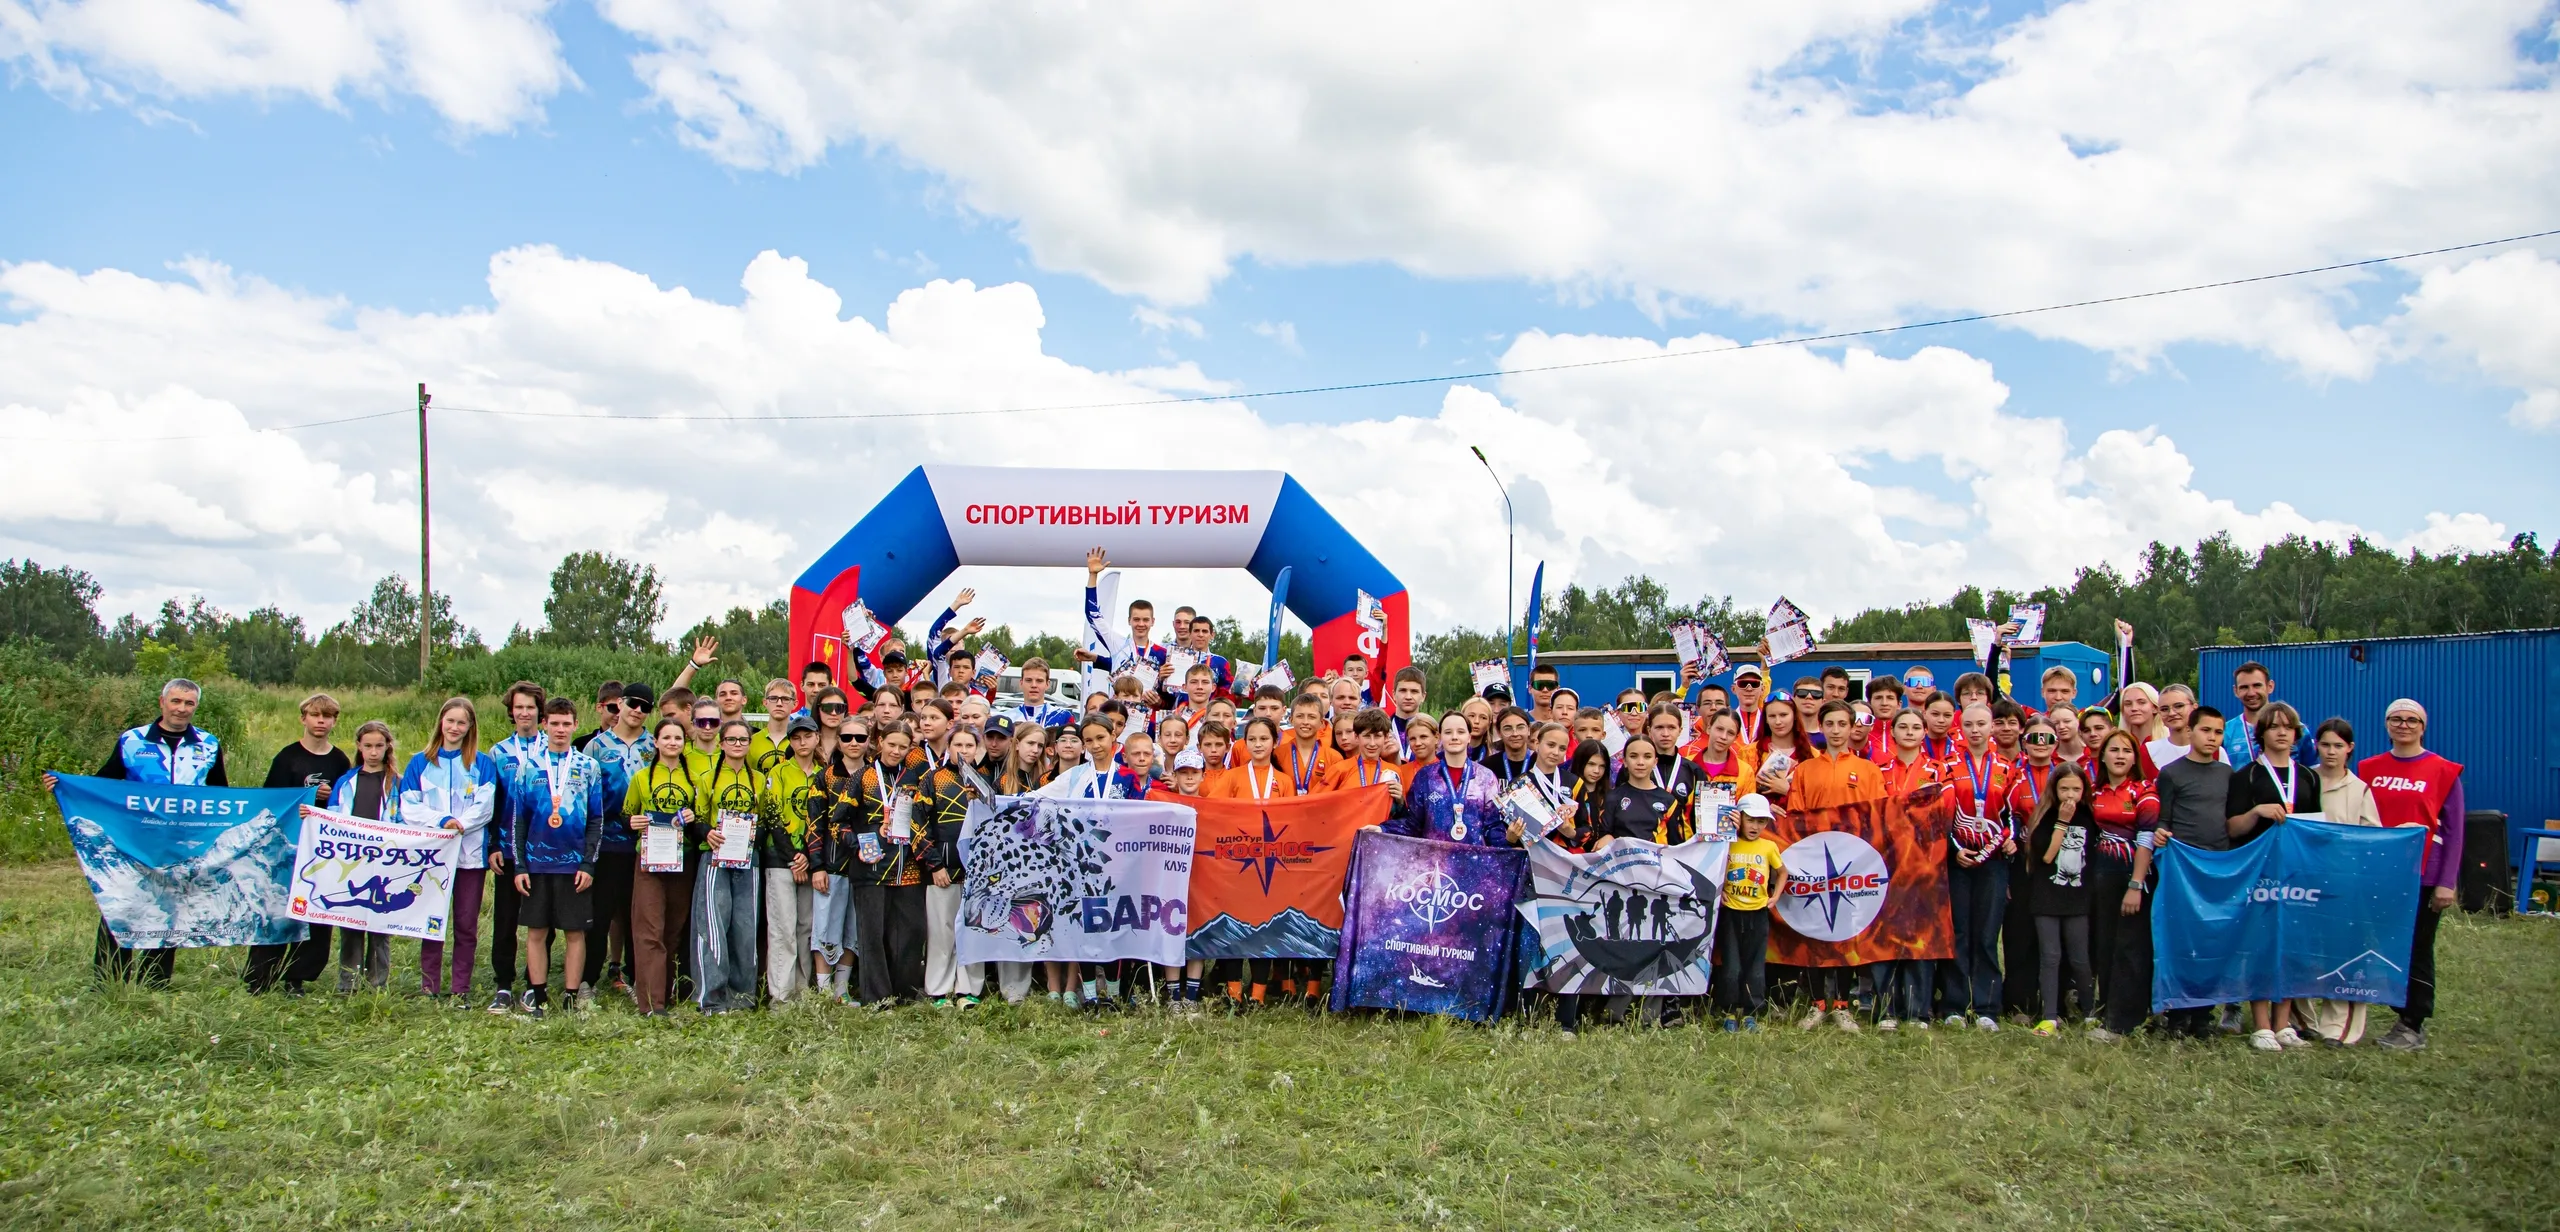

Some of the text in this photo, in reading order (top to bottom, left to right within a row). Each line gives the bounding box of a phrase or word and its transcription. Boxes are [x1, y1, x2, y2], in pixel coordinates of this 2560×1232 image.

[965, 501, 1249, 525] СПОРТИВНЫЙ ТУРИЗМ
[2371, 776, 2427, 793] СУДЬЯ
[126, 795, 249, 815] EVEREST
[319, 823, 384, 843] Команда
[338, 818, 357, 827] ШКОЛА
[358, 822, 399, 834] ОЛИМПИЙСКОГО
[400, 828, 422, 837] РЕЗЕРВА
[1149, 824, 1194, 839] ВОЕННО
[315, 839, 445, 867] ВИРАЖ
[1115, 841, 1191, 856] СПОРТИВНЫЙ
[1215, 841, 1315, 860] КОСМОС
[1164, 859, 1188, 873] КЛУБ
[1281, 856, 1313, 864] Челябинск
[1384, 882, 1485, 911] КОСМОС
[1731, 884, 1759, 897] SKATE
[1845, 889, 1879, 899] Челябинск
[308, 912, 368, 927] ЧЕЛЯБИНСКАЯ ОБЛАСТЬ
[1082, 894, 1187, 936] БАРС
[387, 923, 422, 933] ГОРОД МИАСС
[1385, 939, 1475, 962] СПОРТИВНЫЙ ТУРИЗМ
[2334, 986, 2379, 998] СИРИУС
